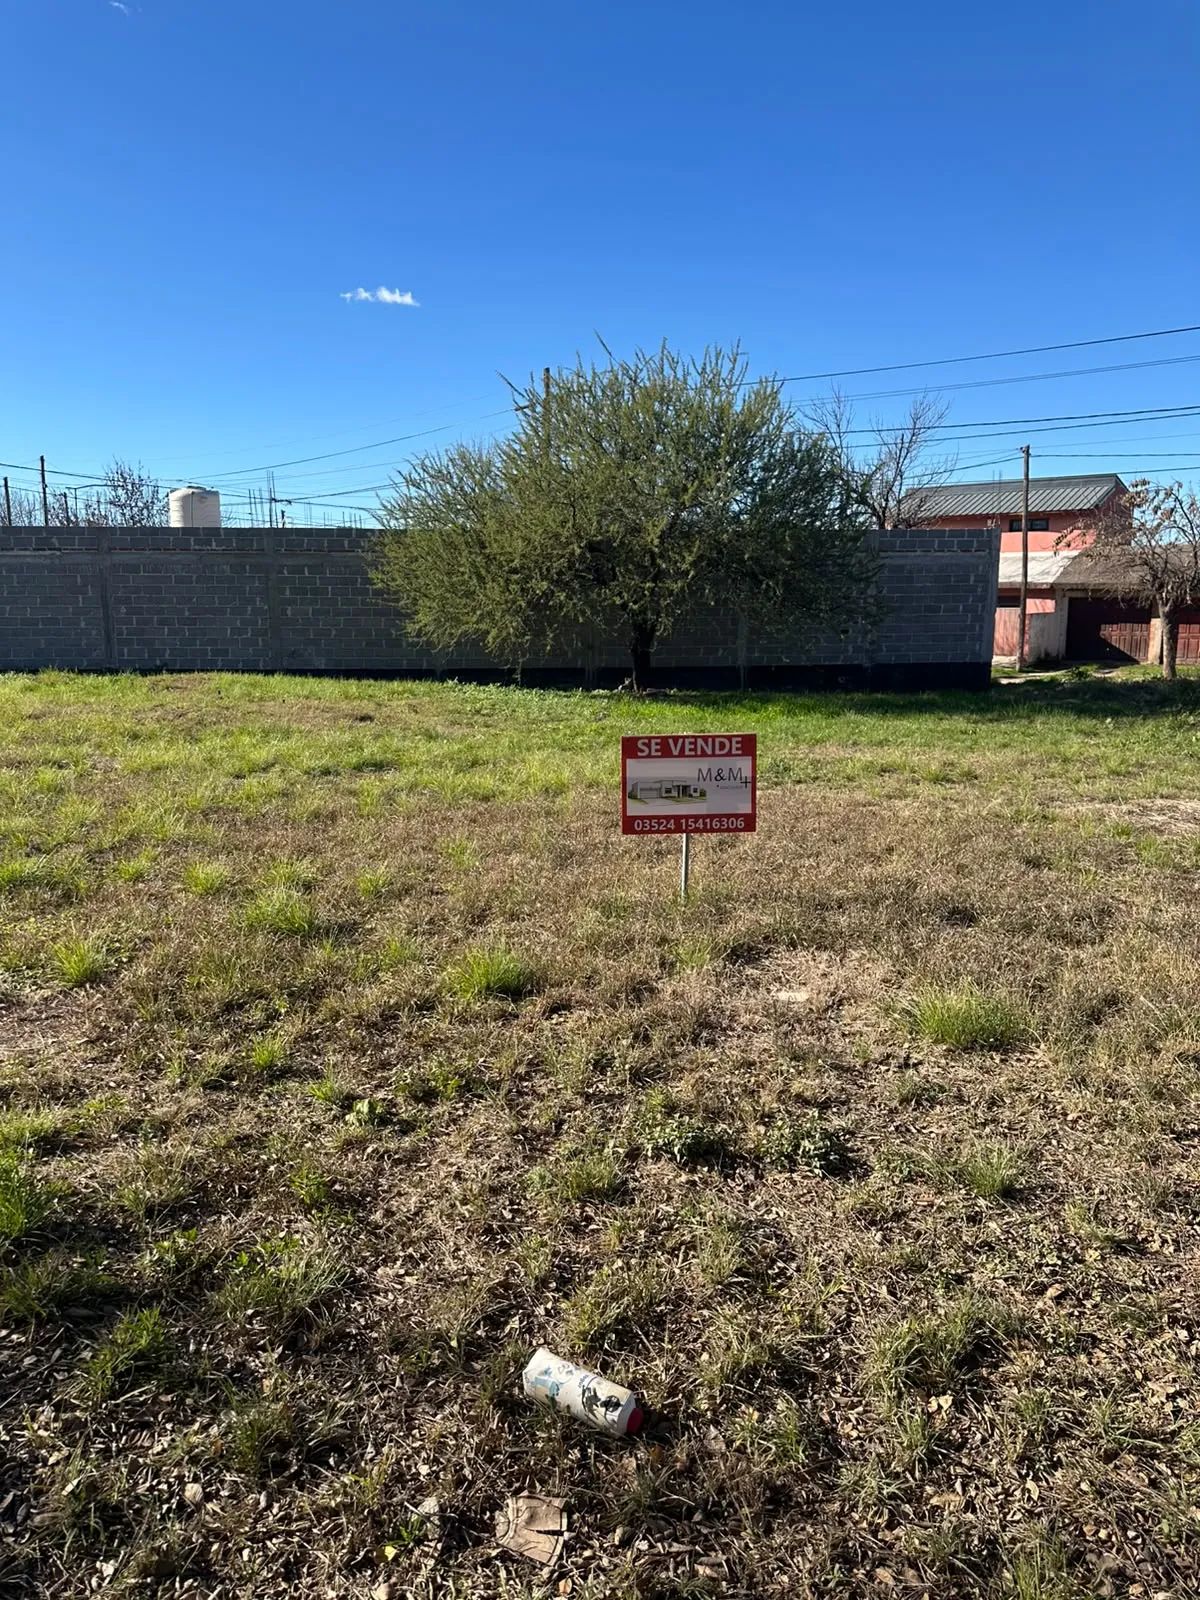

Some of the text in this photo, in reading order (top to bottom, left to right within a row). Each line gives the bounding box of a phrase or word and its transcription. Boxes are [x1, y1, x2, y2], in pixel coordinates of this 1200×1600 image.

[637, 737, 742, 756] SE VENDE
[634, 817, 745, 831] 03524 15416306
